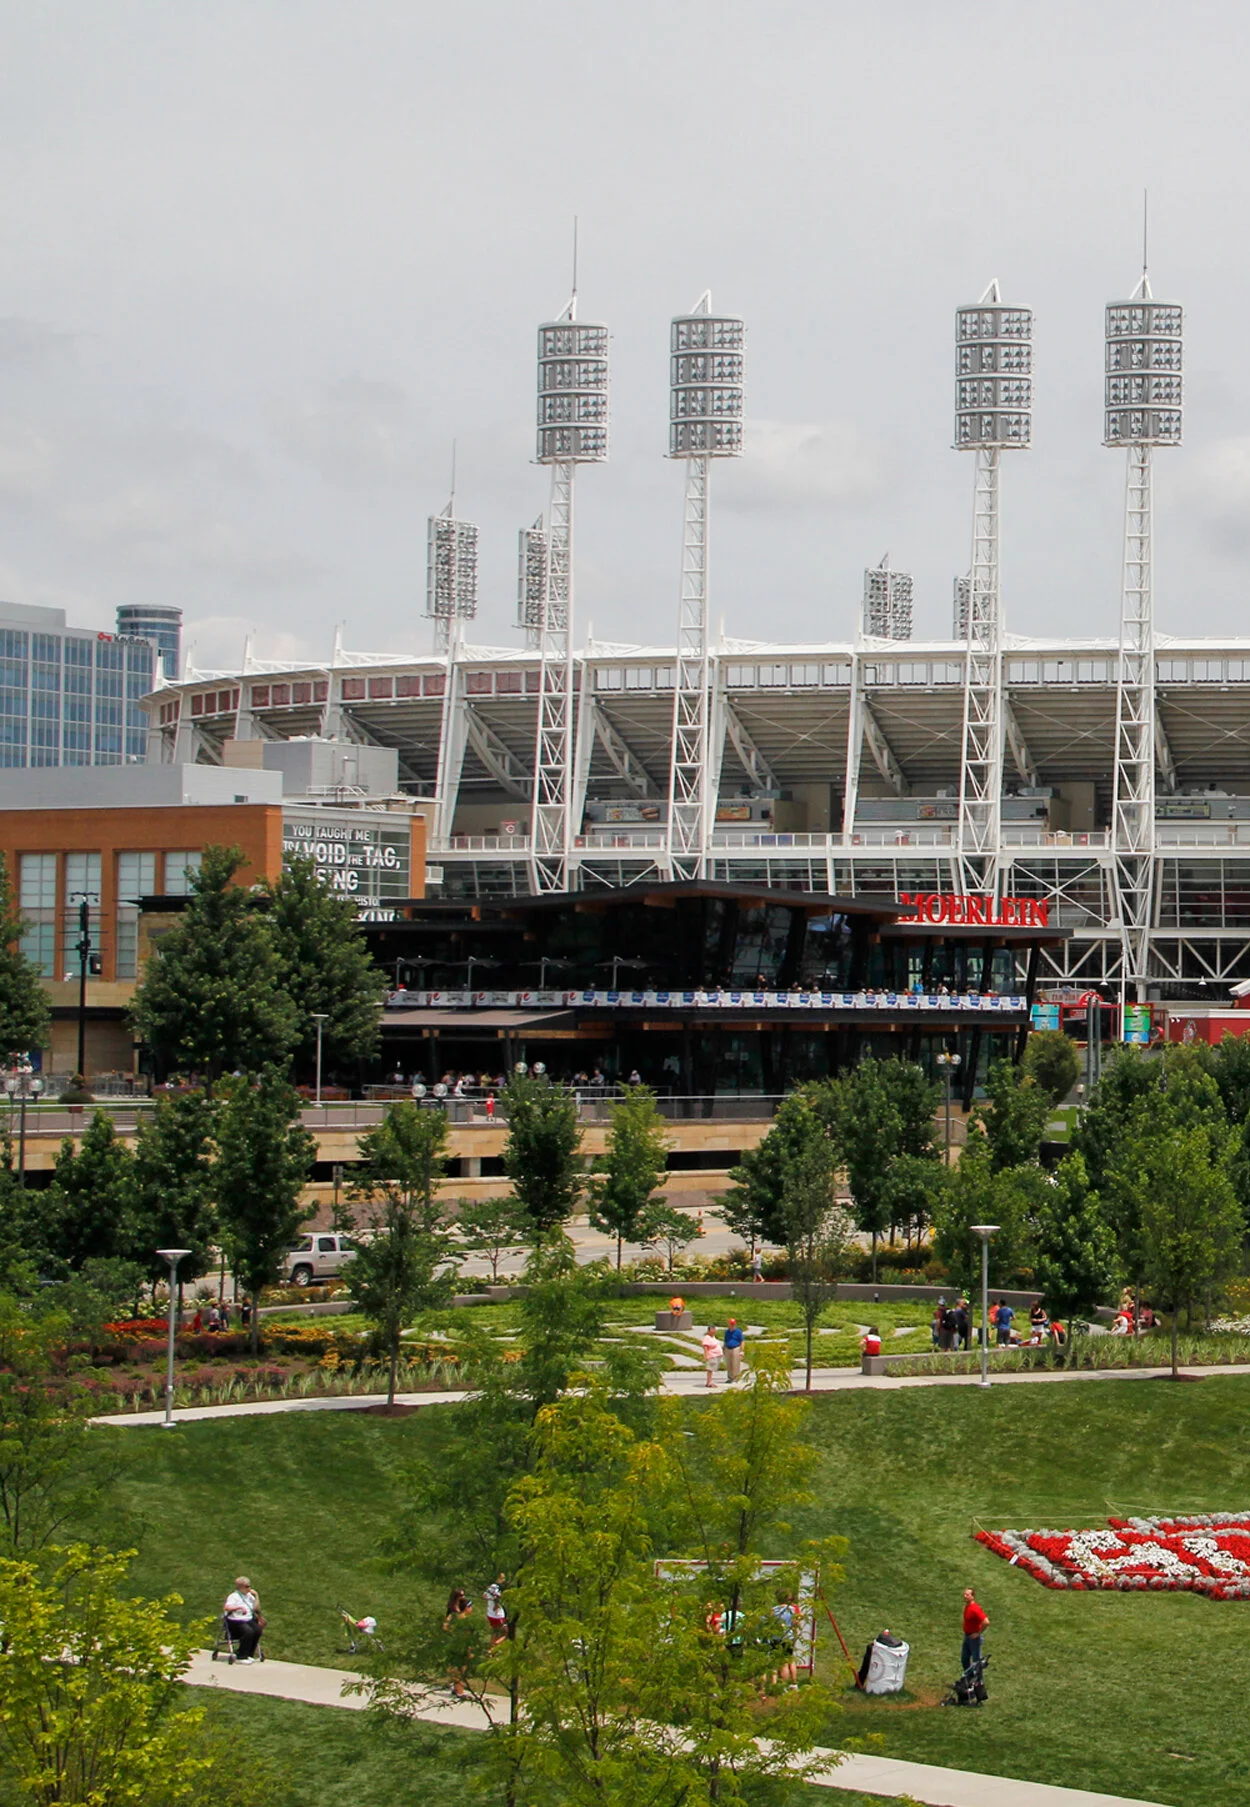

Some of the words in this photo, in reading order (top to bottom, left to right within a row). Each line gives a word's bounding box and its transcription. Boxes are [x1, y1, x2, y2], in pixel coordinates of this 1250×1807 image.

[292, 825, 312, 837] YOU
[315, 827, 353, 840] TAUGHT
[355, 830, 371, 841] ME
[348, 855, 363, 866] THE
[363, 845, 401, 870] TAG,
[898, 892, 1049, 927] MOERLEIN
